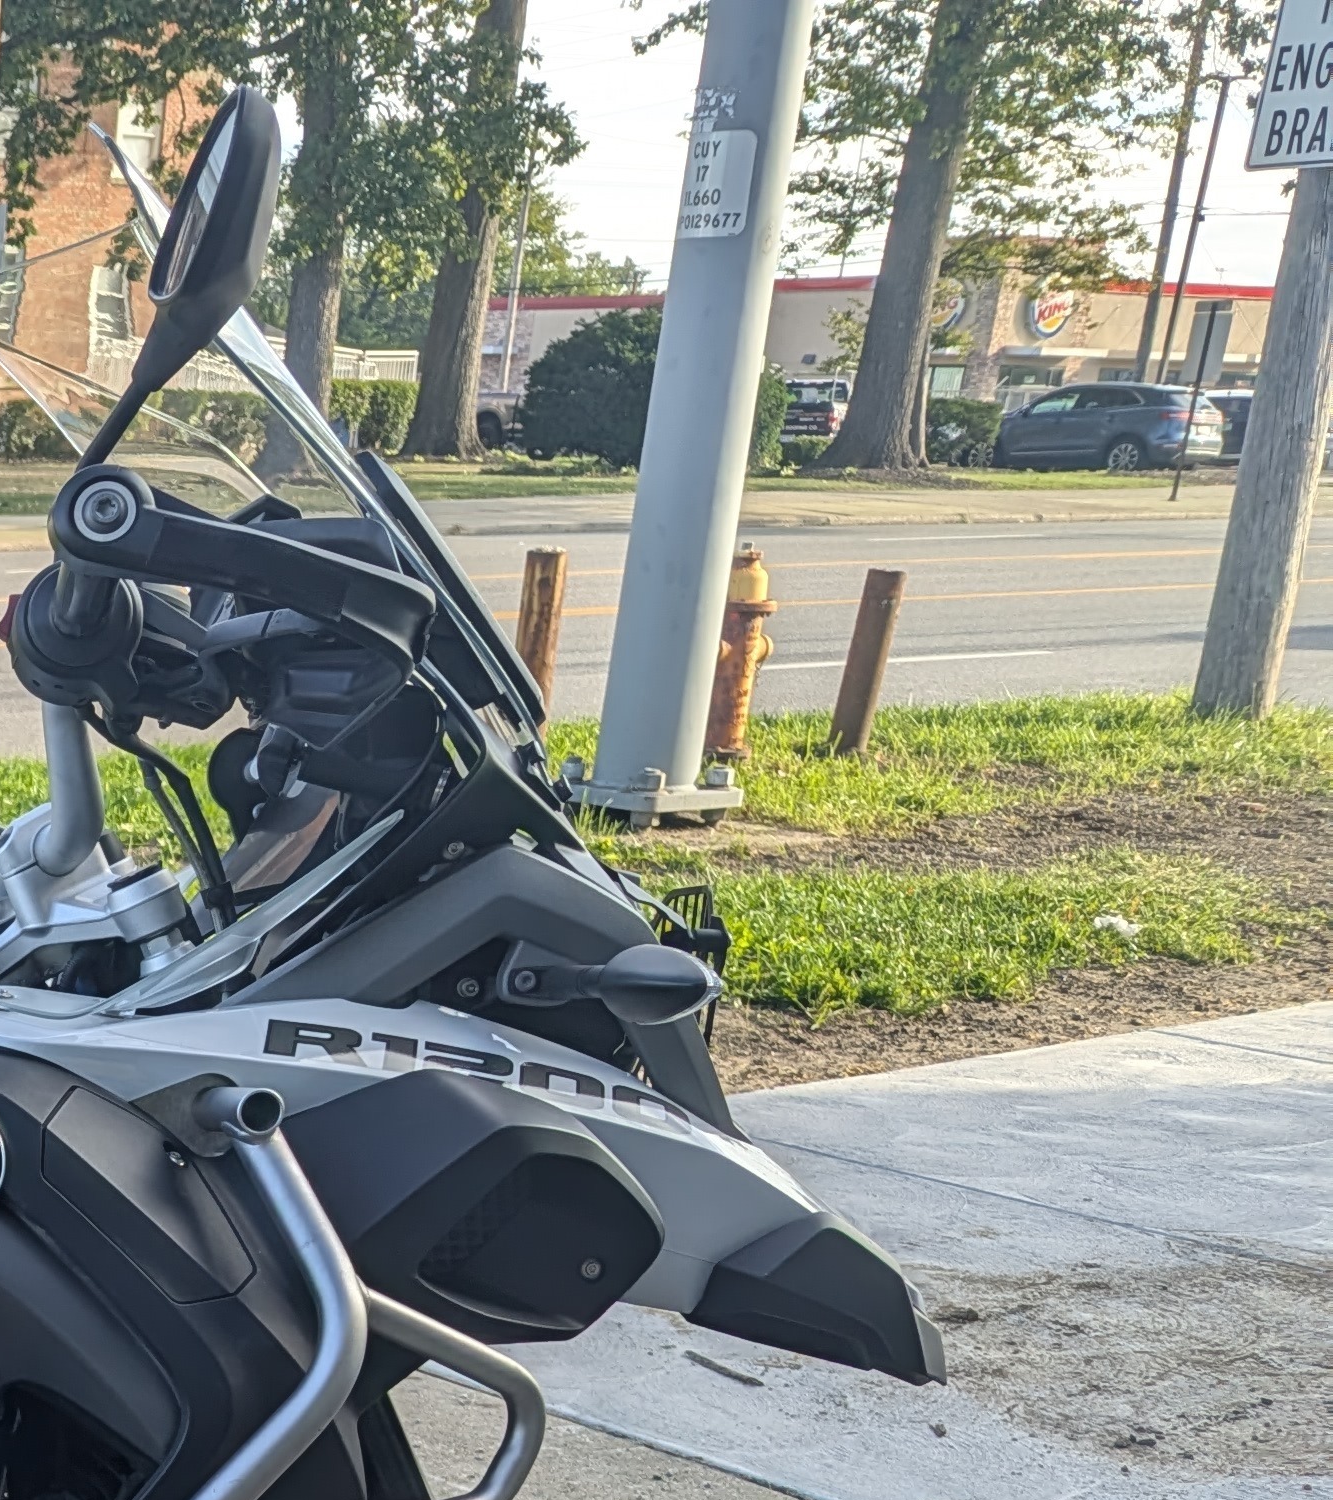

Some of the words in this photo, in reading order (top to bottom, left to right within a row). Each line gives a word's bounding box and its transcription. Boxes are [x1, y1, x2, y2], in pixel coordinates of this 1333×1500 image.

[694, 140, 721, 159] CUY
[695, 165, 709, 182] 17
[262, 1018, 692, 1136] R1200
